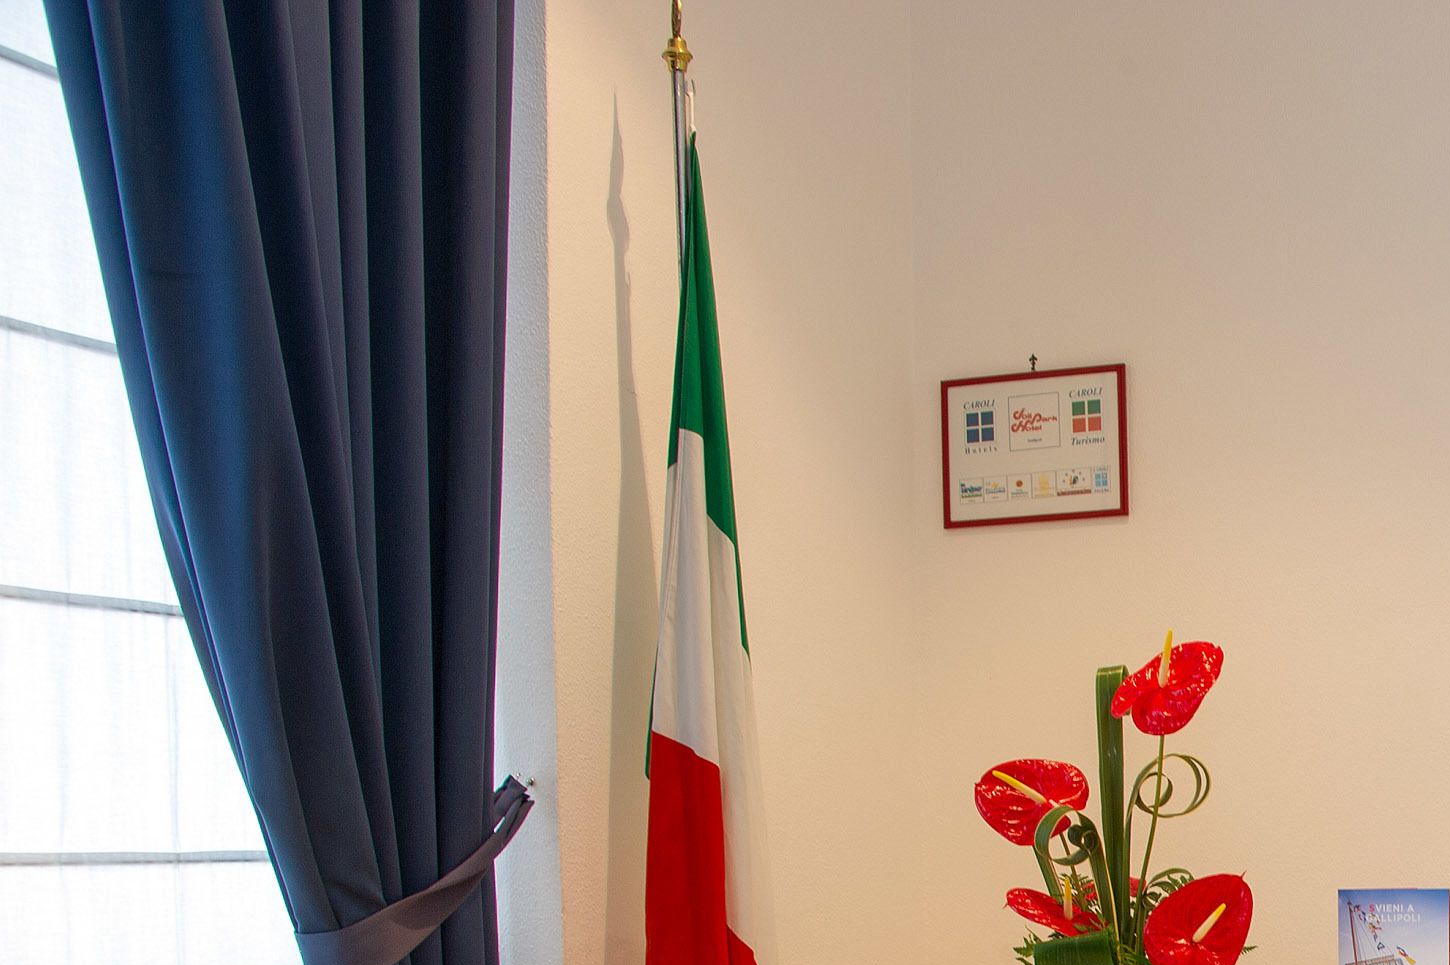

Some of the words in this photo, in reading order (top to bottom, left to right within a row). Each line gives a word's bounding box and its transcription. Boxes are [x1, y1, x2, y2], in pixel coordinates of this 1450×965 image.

[1069, 387, 1103, 398] CAROLI
[963, 399, 996, 410] CAROLI
[1071, 436, 1105, 446] Turismo
[1407, 903, 1415, 912] A
[1366, 913, 1421, 922] GALLIPOLI
